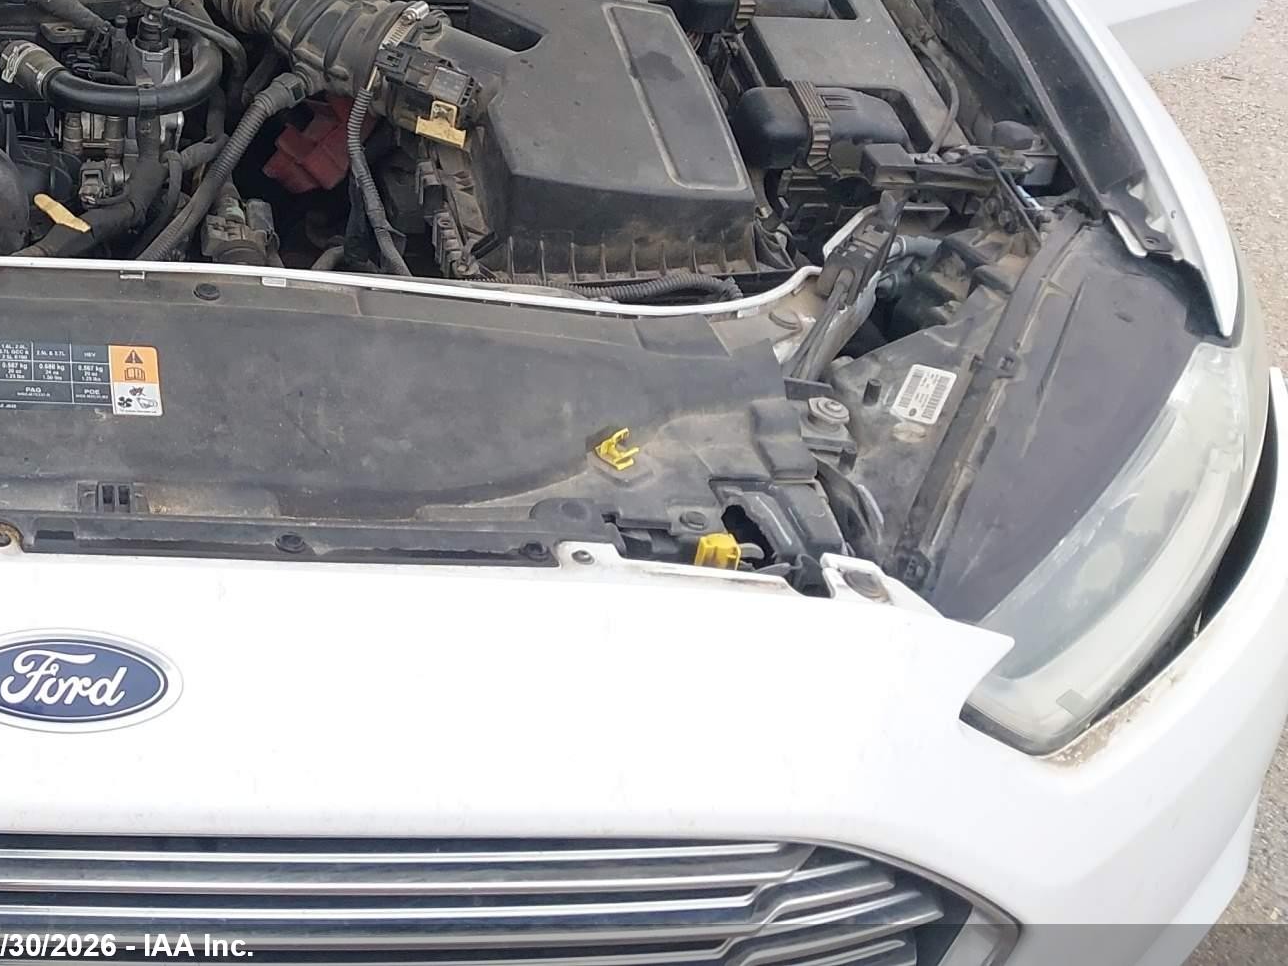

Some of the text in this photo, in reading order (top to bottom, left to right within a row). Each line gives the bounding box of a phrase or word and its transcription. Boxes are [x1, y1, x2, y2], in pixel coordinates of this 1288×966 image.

[19, 362, 28, 370] kg
[57, 364, 65, 372] kg
[95, 365, 103, 373] kg
[0, 649, 128, 707] Ford
